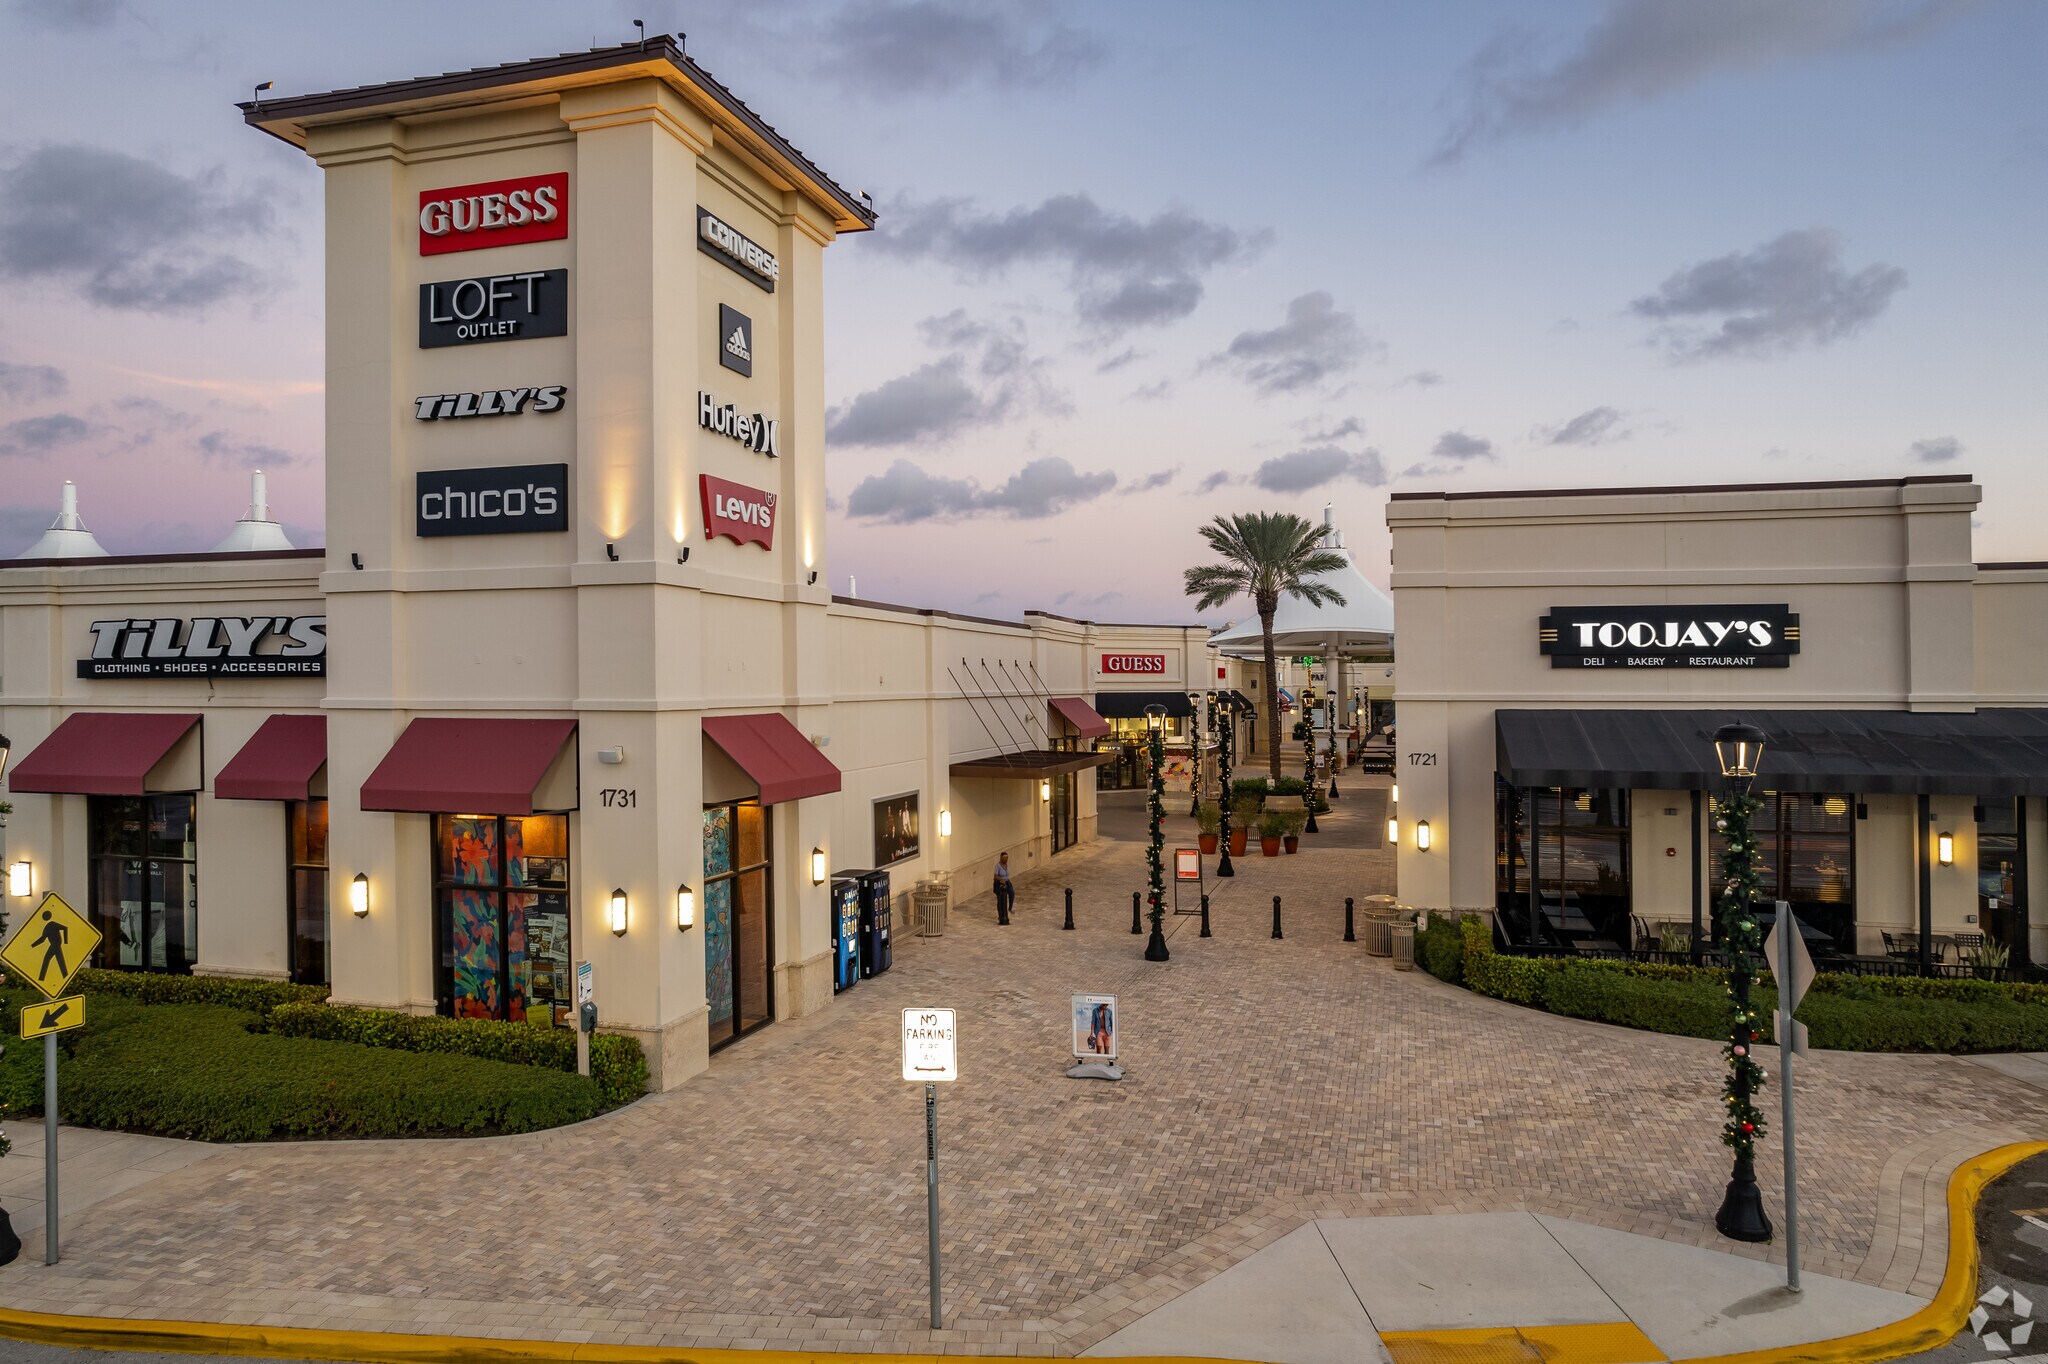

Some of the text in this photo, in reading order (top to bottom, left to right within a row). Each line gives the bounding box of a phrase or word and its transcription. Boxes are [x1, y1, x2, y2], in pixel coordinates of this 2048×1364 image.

[420, 186, 557, 236] GUESS
[701, 216, 779, 281] CONVERSE
[430, 272, 545, 323] LOFT
[457, 320, 516, 338] OUTLET
[726, 342, 751, 361] adidas
[698, 390, 760, 451] Hurley
[421, 483, 558, 520] chico's
[1572, 620, 1772, 648] TOOJAY'S
[94, 662, 321, 674] CLOTHING SHOES ACCESSORIES
[1107, 656, 1163, 671] GUESS
[1583, 657, 1756, 666] DELI BAKERY RESTAURANT
[1408, 752, 1437, 766] 1721
[599, 788, 636, 808] 1731
[132, 860, 159, 869] VS
[920, 1014, 938, 1026] NO
